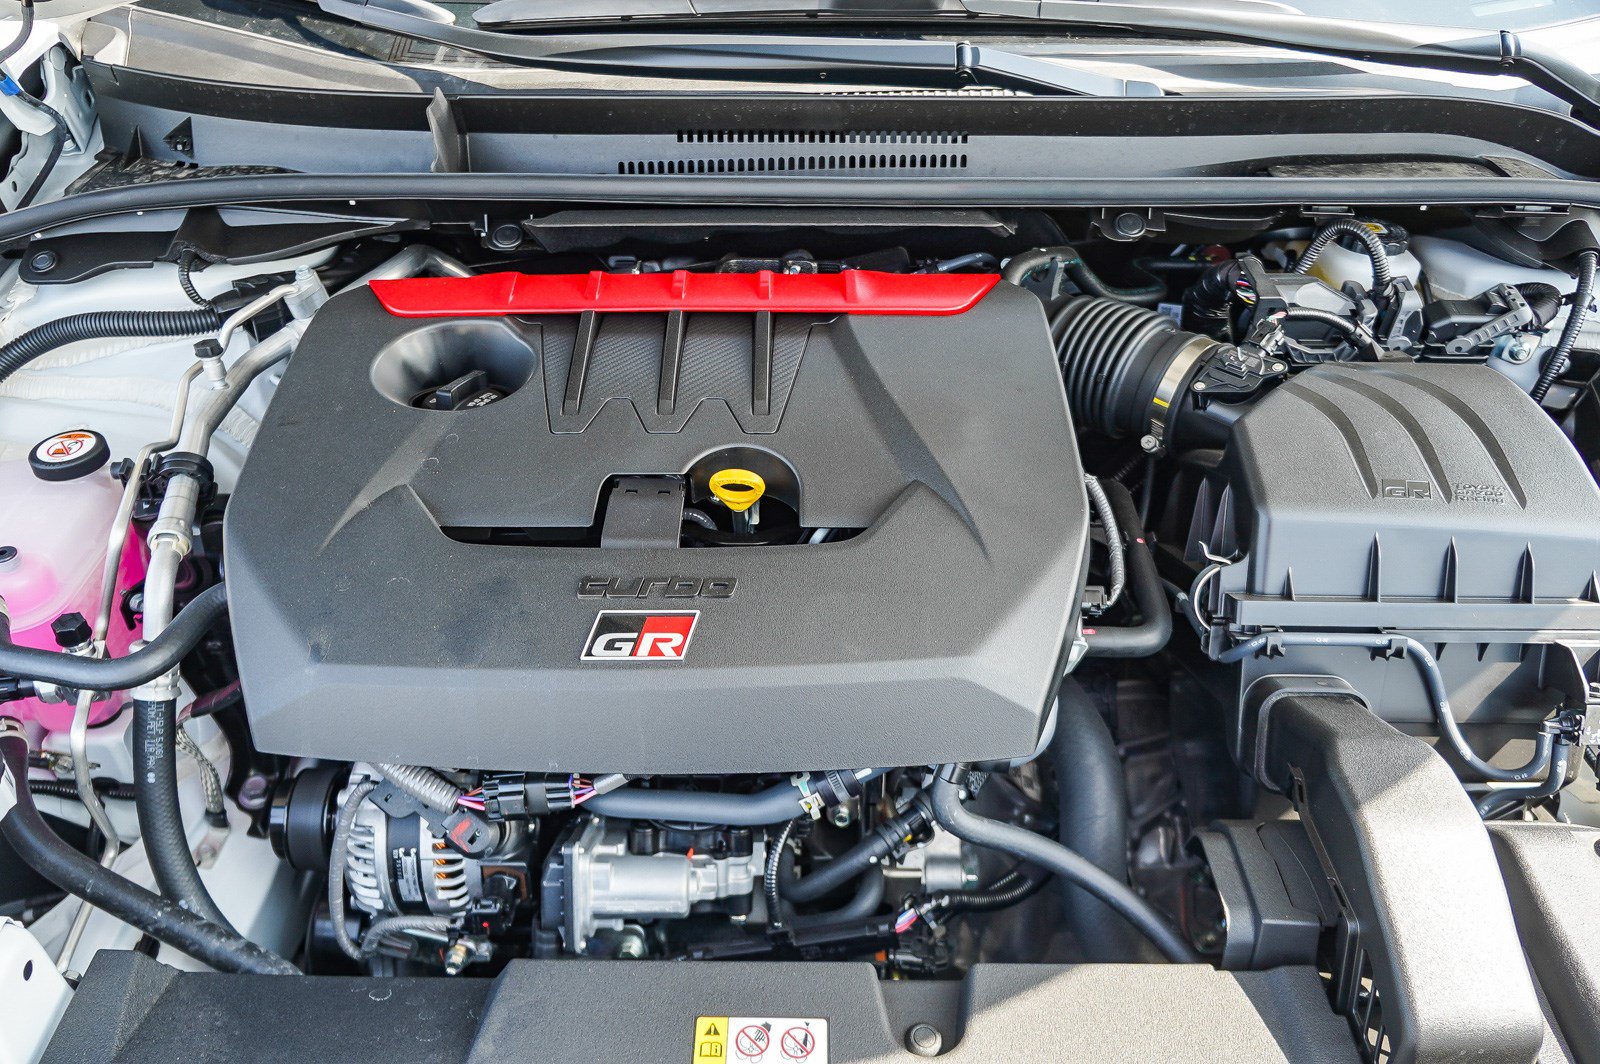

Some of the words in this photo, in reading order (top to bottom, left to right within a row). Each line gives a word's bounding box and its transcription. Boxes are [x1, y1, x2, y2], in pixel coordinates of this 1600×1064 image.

[1384, 485, 1431, 499] GR
[577, 577, 738, 599] turbo
[591, 632, 685, 657] GR
